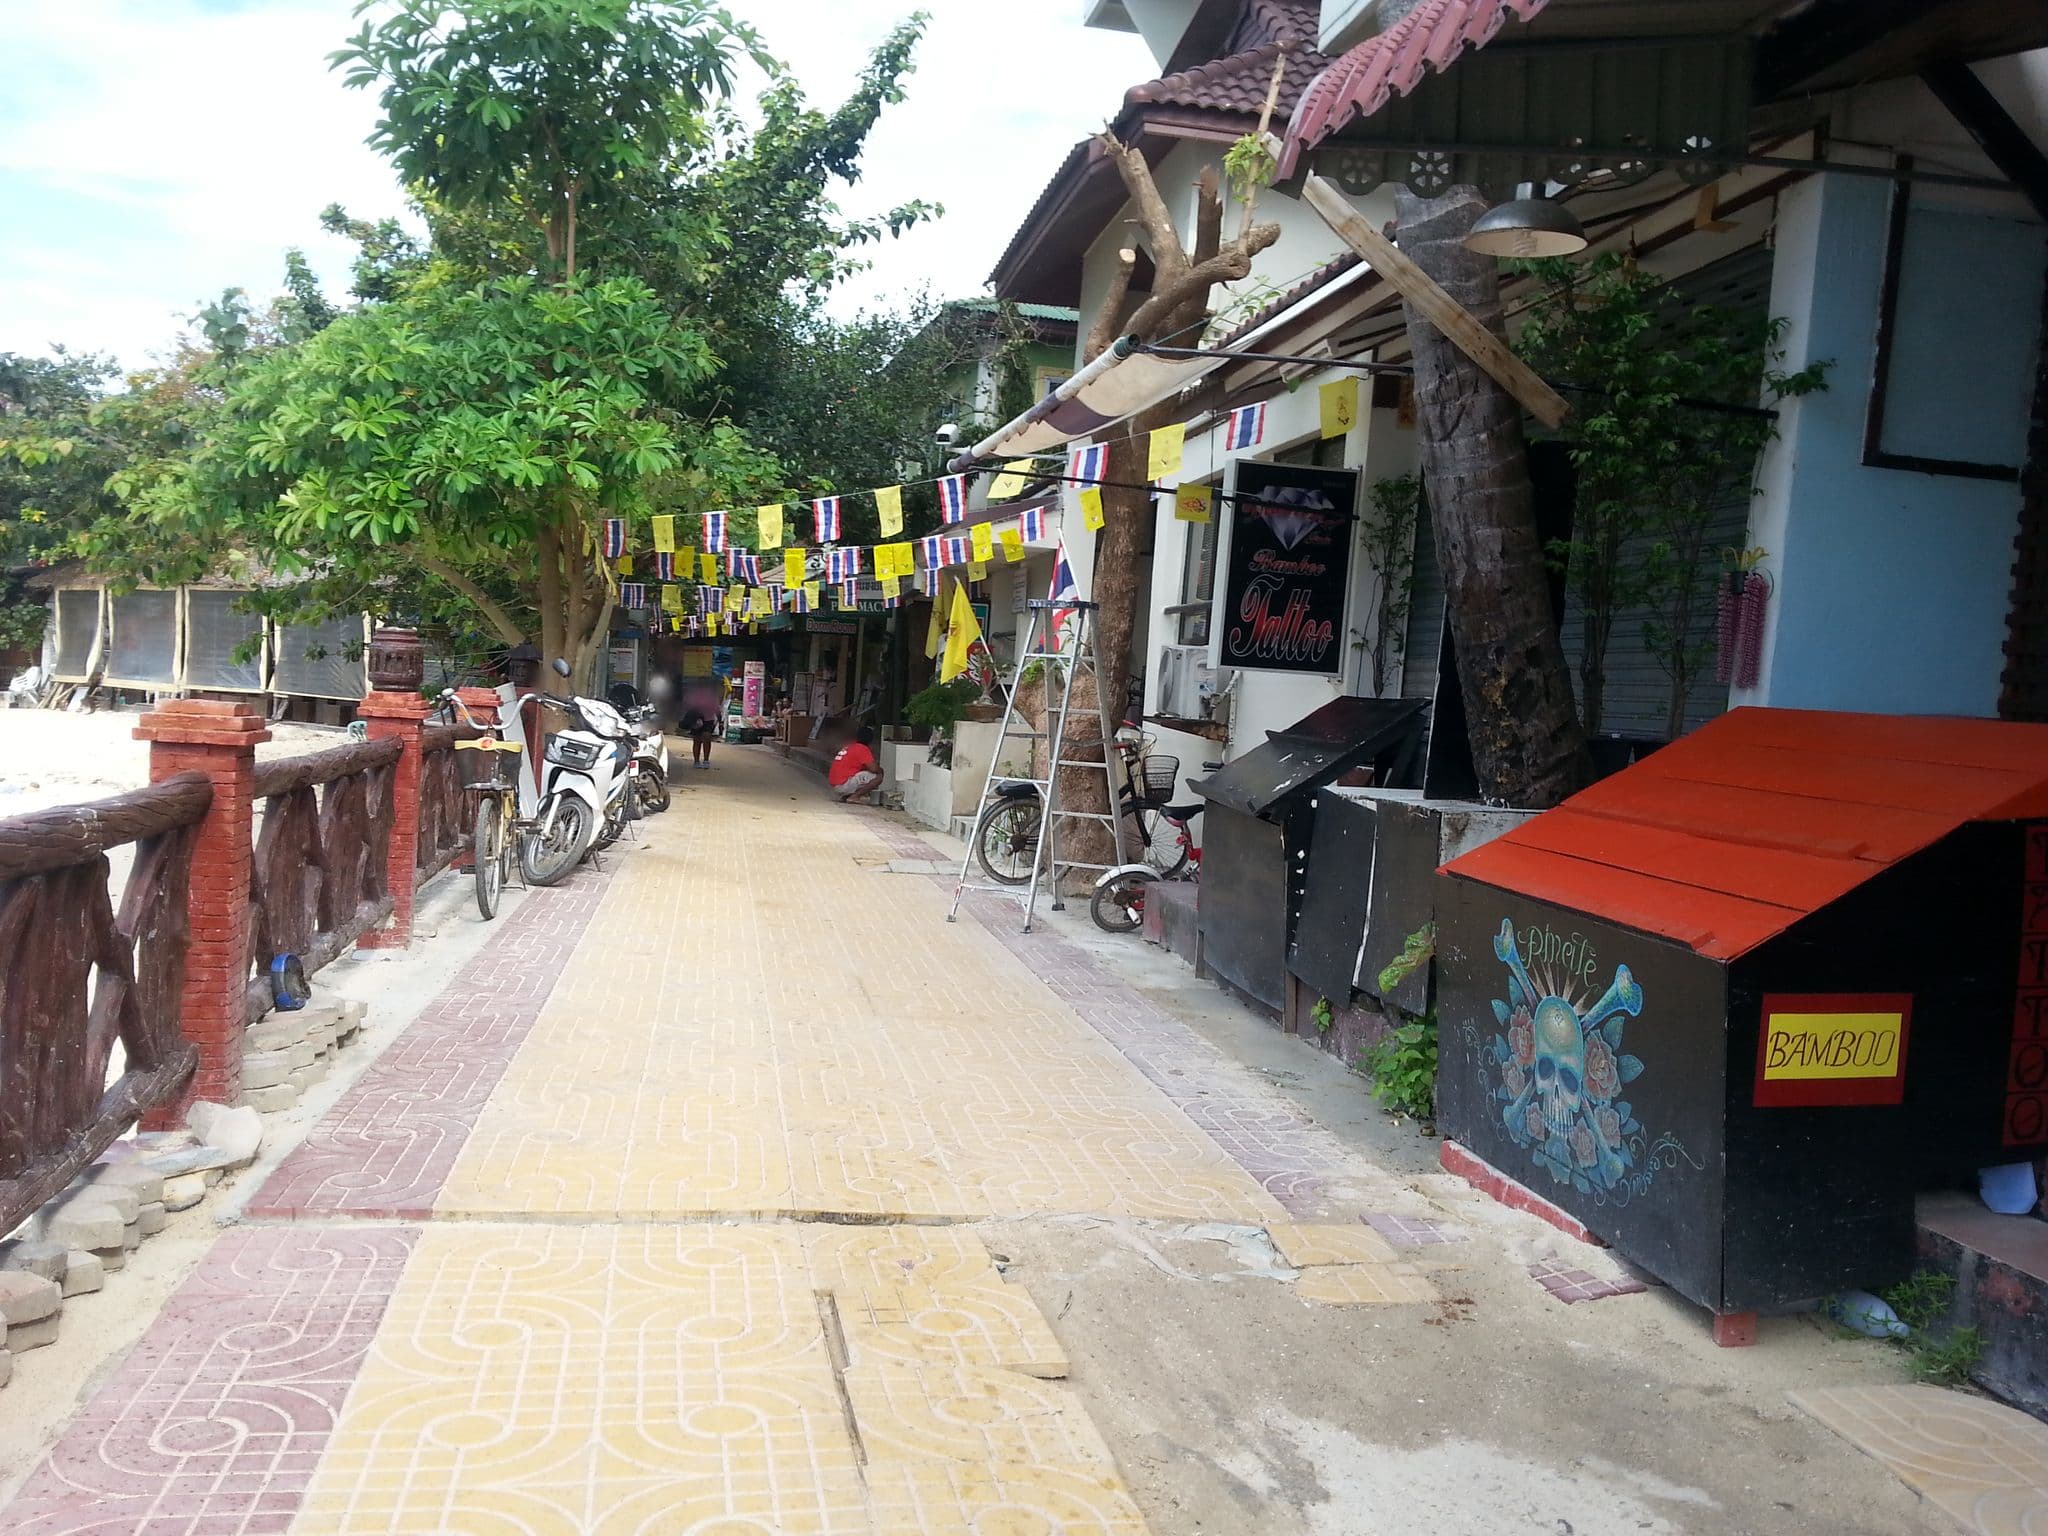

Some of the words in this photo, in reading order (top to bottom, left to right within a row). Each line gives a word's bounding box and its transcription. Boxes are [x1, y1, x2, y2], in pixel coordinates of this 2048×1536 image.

[831, 600, 887, 613] PMACY
[1229, 573, 1335, 663] Tattoo
[1766, 1029, 1897, 1068] BAMBOO
